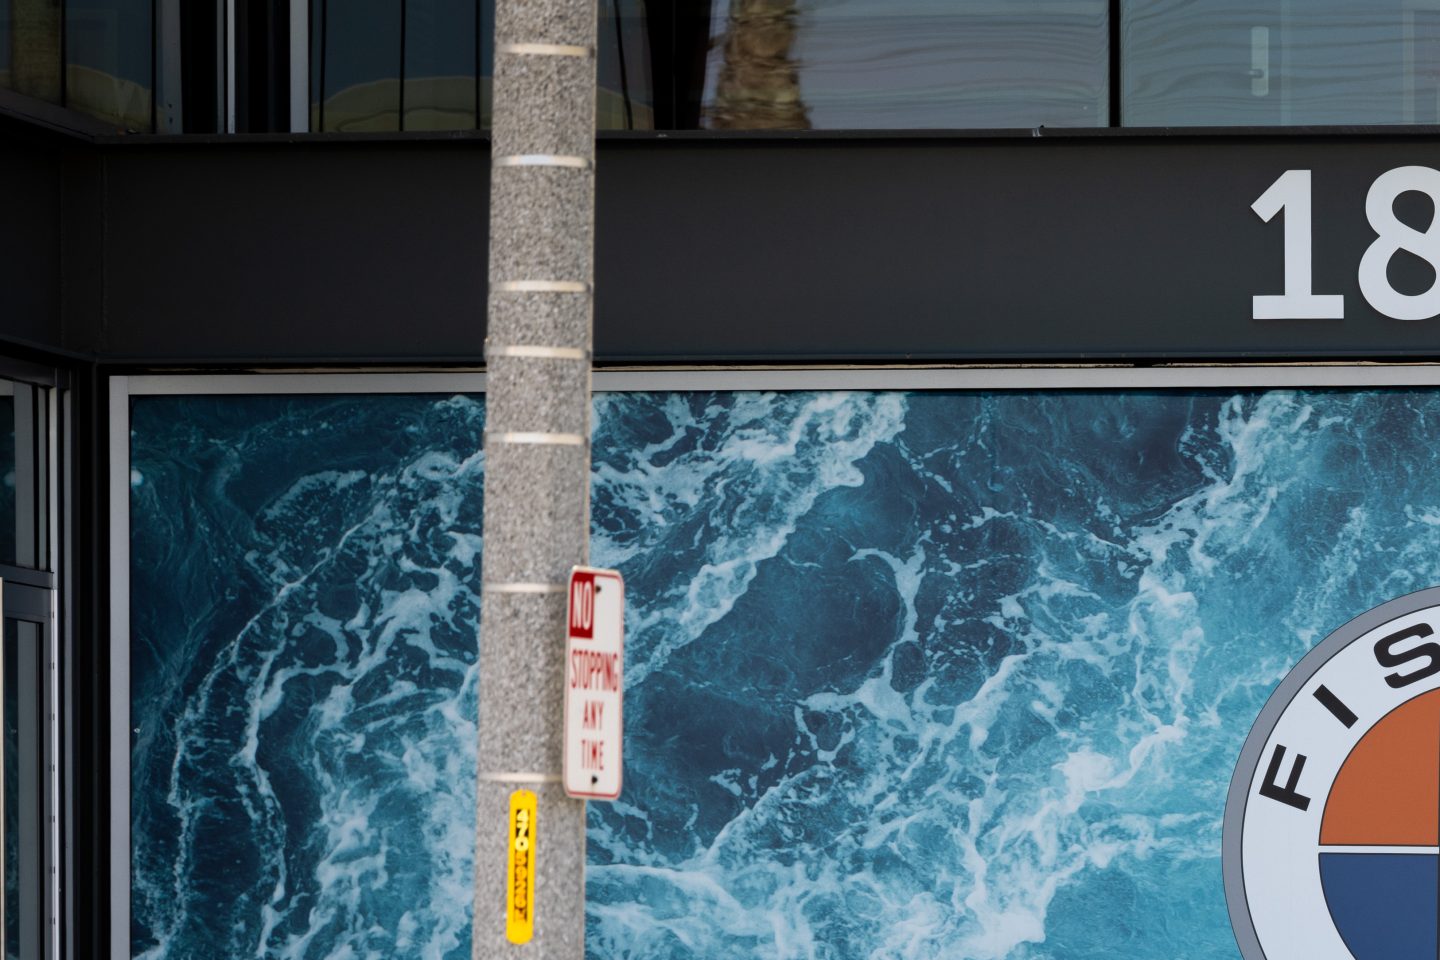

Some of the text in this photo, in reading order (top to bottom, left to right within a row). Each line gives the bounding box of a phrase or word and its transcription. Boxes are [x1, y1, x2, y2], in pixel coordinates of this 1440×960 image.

[572, 581, 592, 630] NO
[571, 649, 618, 692] STOPPING
[583, 701, 604, 730] ANY
[582, 739, 604, 771] TIME
